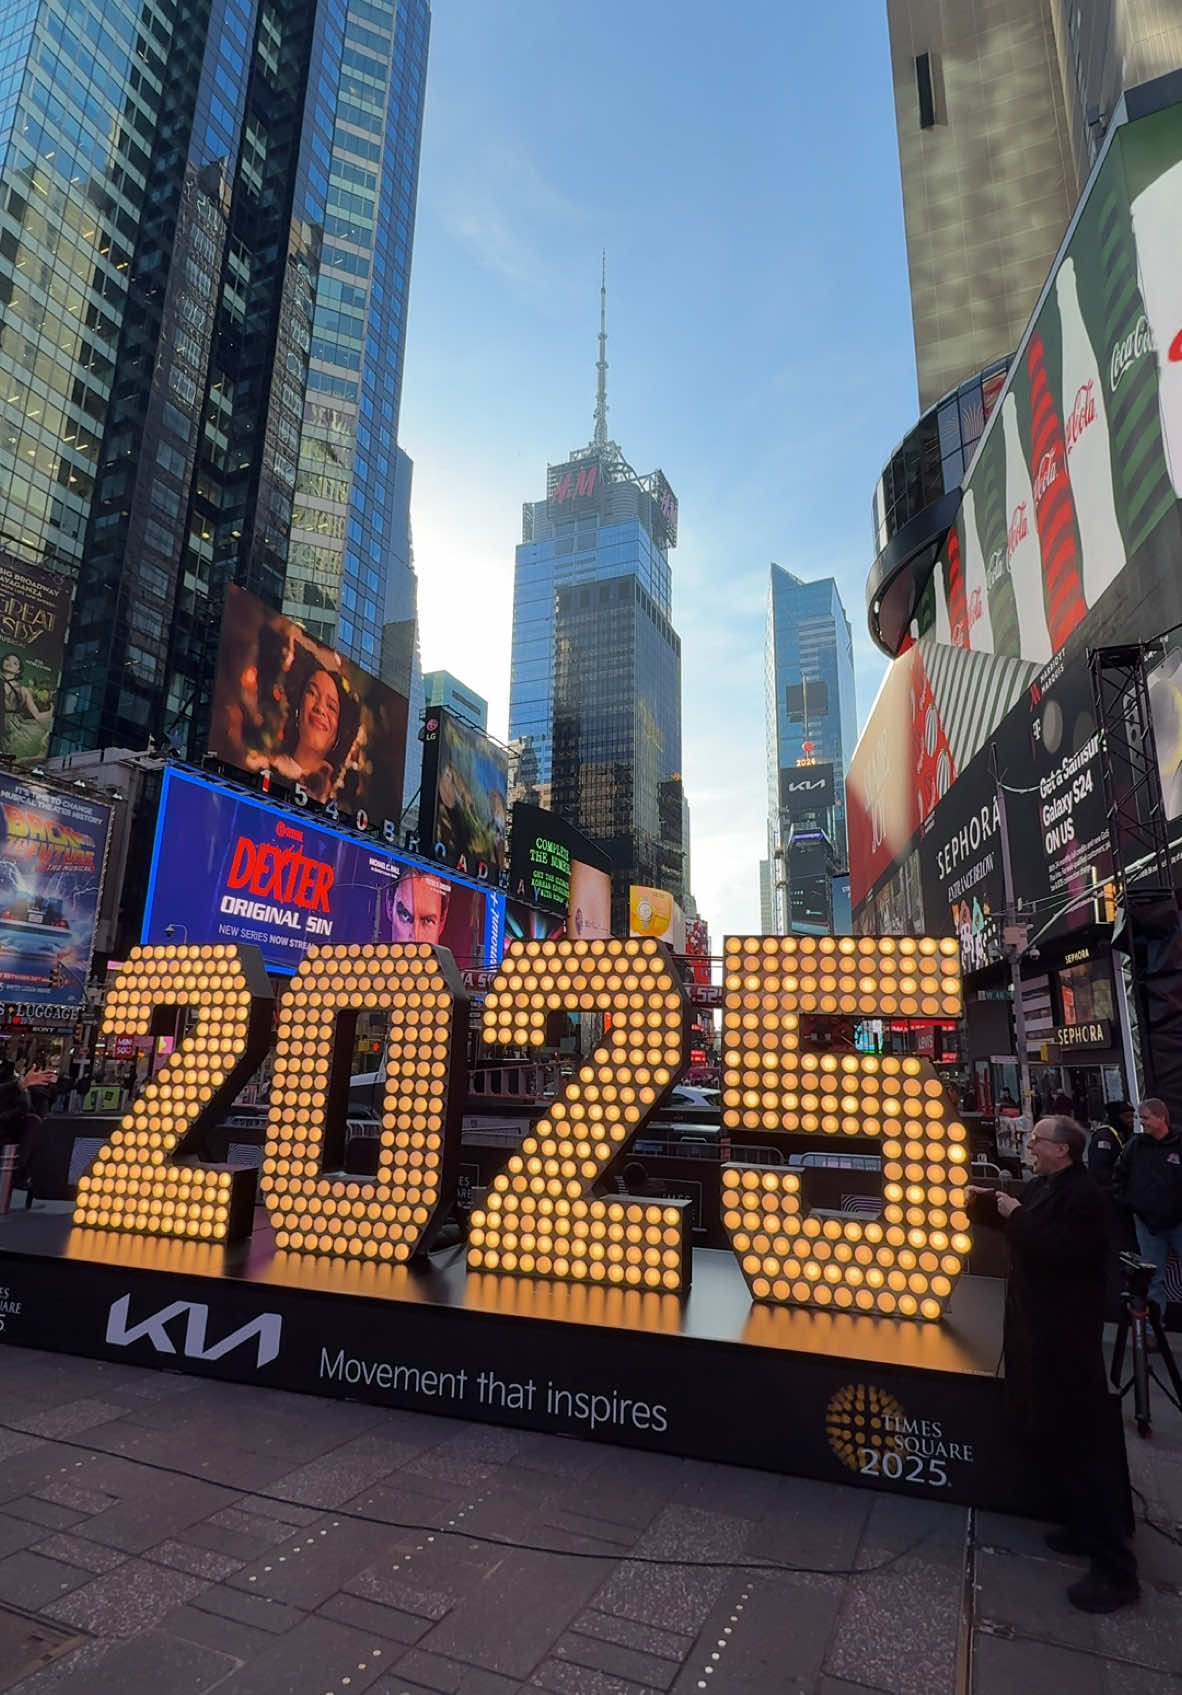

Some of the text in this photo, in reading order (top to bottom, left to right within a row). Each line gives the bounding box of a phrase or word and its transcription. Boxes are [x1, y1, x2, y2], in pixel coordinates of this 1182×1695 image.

[14, 572, 59, 597] BROADWAY
[426, 732, 437, 741] LG
[1040, 770, 1057, 799] Get
[1043, 769, 1093, 827] Galaxy S24
[937, 795, 1001, 881] SEPHORA
[1045, 827, 1060, 855] ON
[1060, 817, 1075, 845] US
[529, 849, 548, 864] THE
[226, 836, 335, 913] DEXTER
[220, 895, 334, 936] ORIGINAL SIN
[218, 923, 240, 937] NEW
[240, 928, 269, 943] SERIES
[269, 934, 290, 948] NOW
[16, 1002, 80, 1021] LUGGAGE
[1058, 1024, 1105, 1045] SEPHORA
[70, 935, 973, 1321] 2025
[319, 1347, 669, 1432] Movement that inspires
[881, 1414, 943, 1438] TIMES
[894, 1434, 974, 1462] SQUARE
